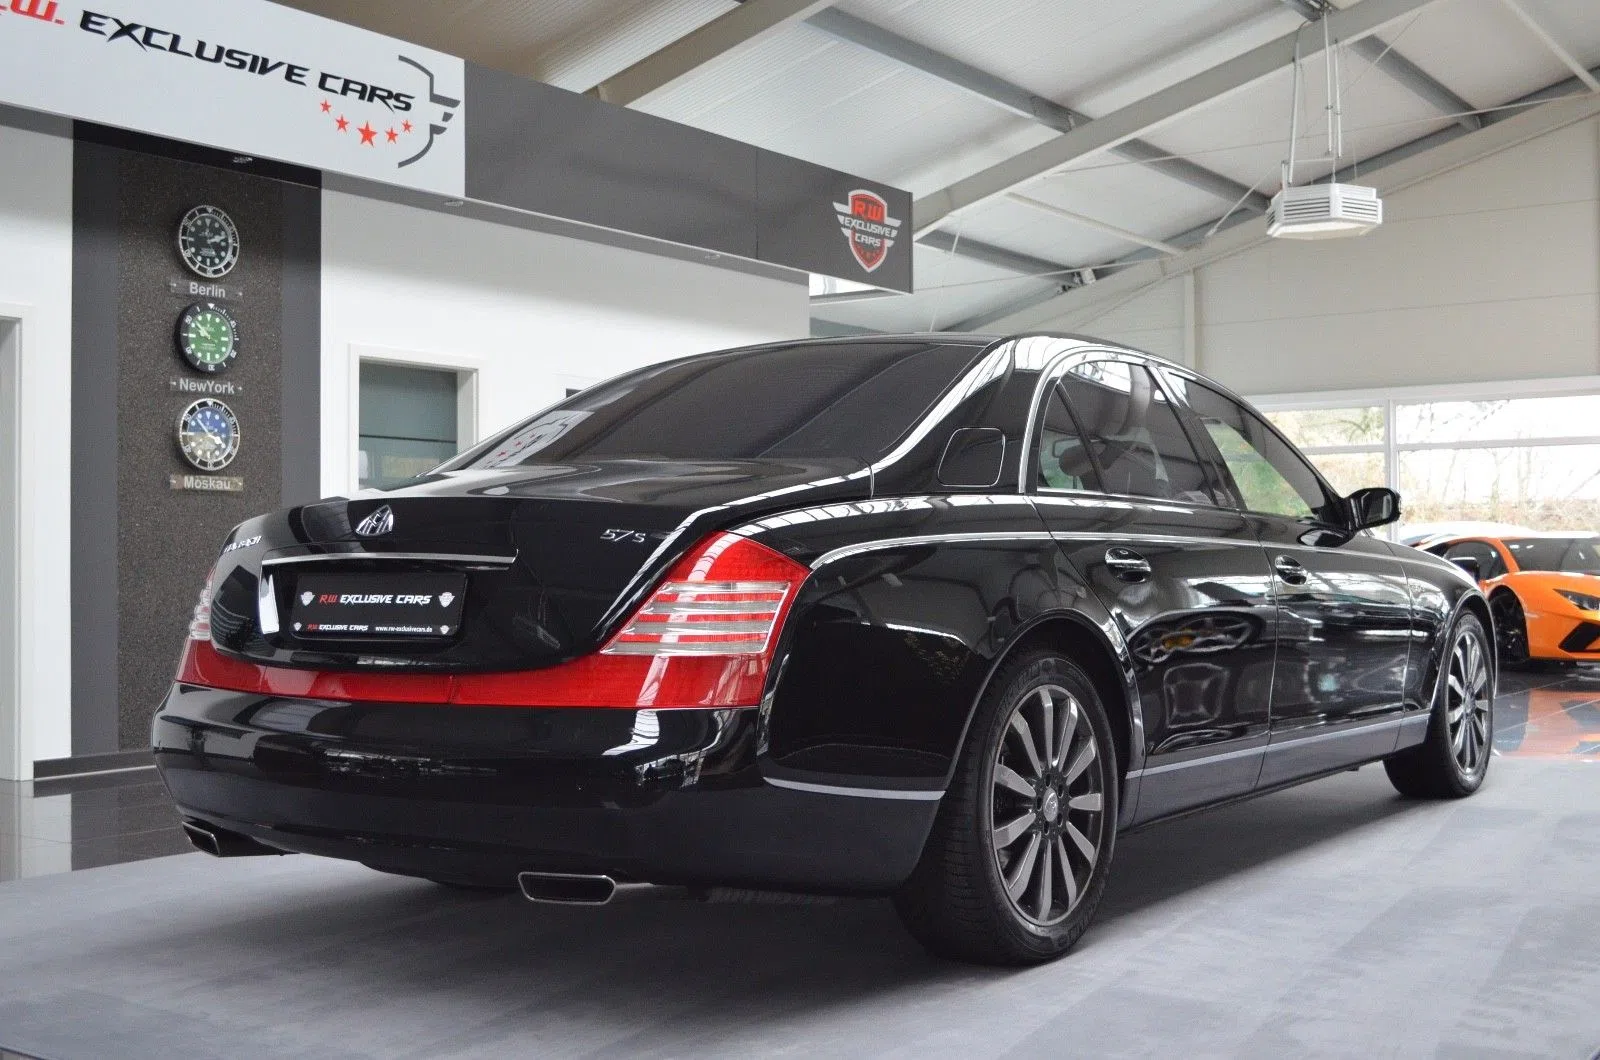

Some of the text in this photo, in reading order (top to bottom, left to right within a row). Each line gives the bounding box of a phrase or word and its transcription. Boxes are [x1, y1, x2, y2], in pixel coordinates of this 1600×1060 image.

[79, 10, 310, 87] EXCLUSIVE
[317, 71, 416, 114] CARS
[854, 200, 883, 221] RW
[844, 217, 892, 238] EXCLUSIVE
[855, 233, 882, 249] CARS
[189, 281, 226, 298] Berlin
[184, 475, 232, 490] Moskau
[319, 594, 433, 606] RW EXCLUSIVE CARS
[349, 624, 369, 632] CARS
